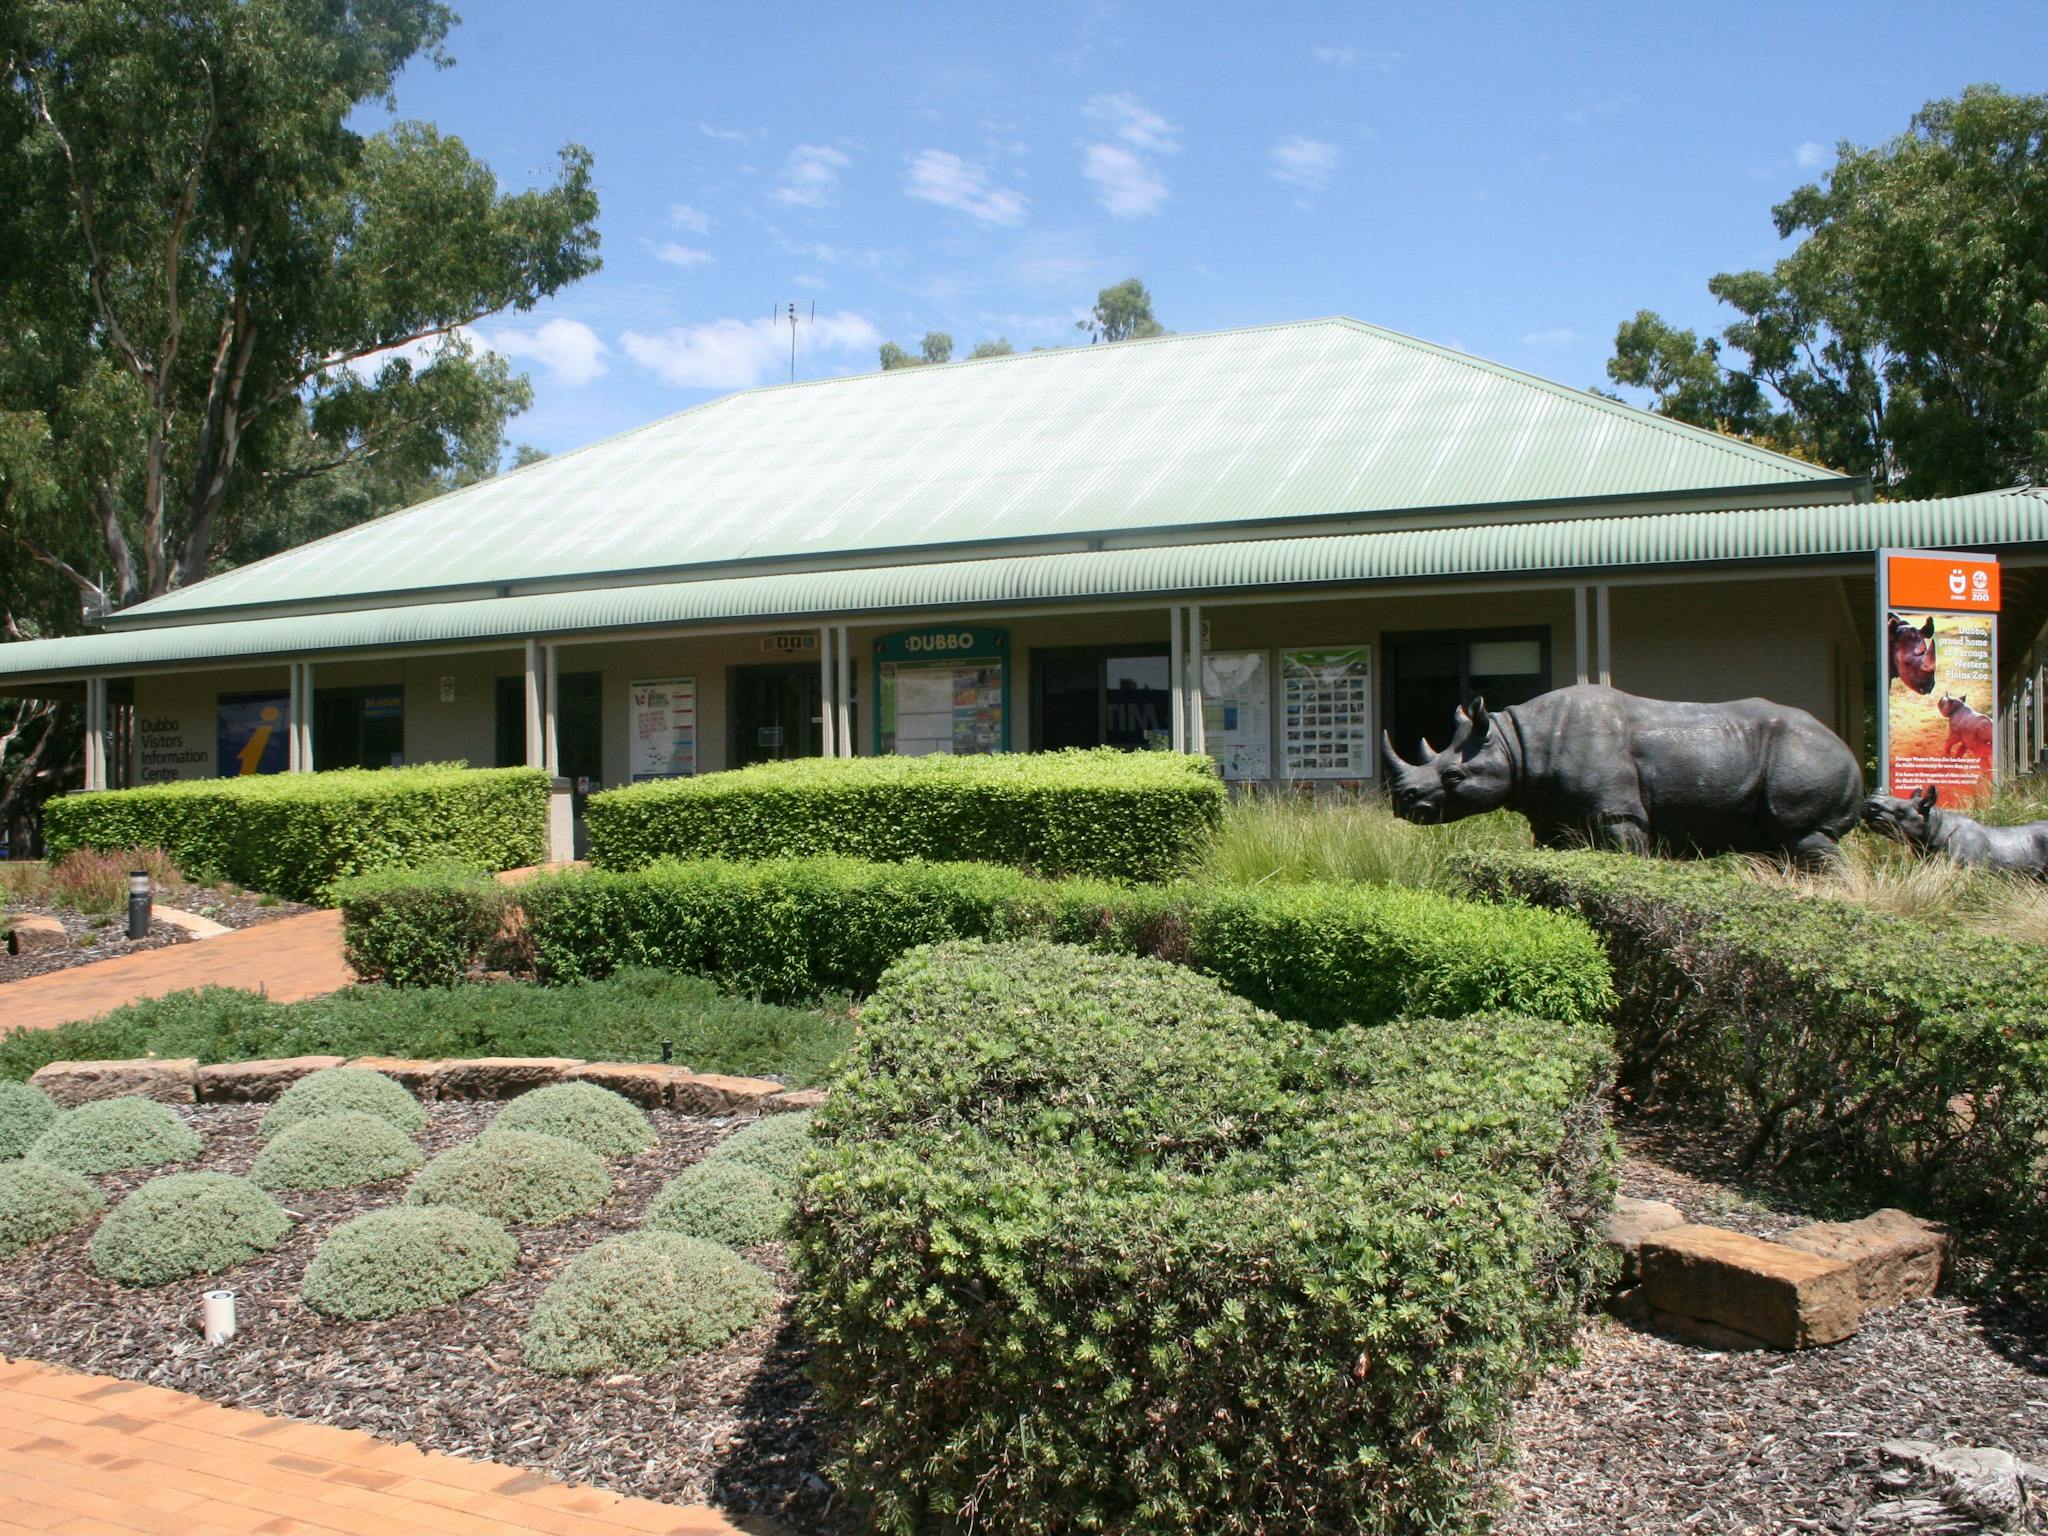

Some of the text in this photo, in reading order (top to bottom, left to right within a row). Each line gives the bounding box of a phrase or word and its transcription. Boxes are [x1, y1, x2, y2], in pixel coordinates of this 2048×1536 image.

[1972, 593, 1989, 601] ZOO
[1959, 624, 1987, 636] Dubbo,
[1940, 636, 1988, 647] proud home
[1944, 647, 1988, 660] of Taronga
[1953, 658, 1988, 668] Western
[1946, 670, 1988, 680] Plains Zoo
[142, 717, 180, 732] Dubbo
[141, 734, 183, 748] Visitors
[142, 749, 208, 764] Information
[142, 767, 179, 781] Centre
